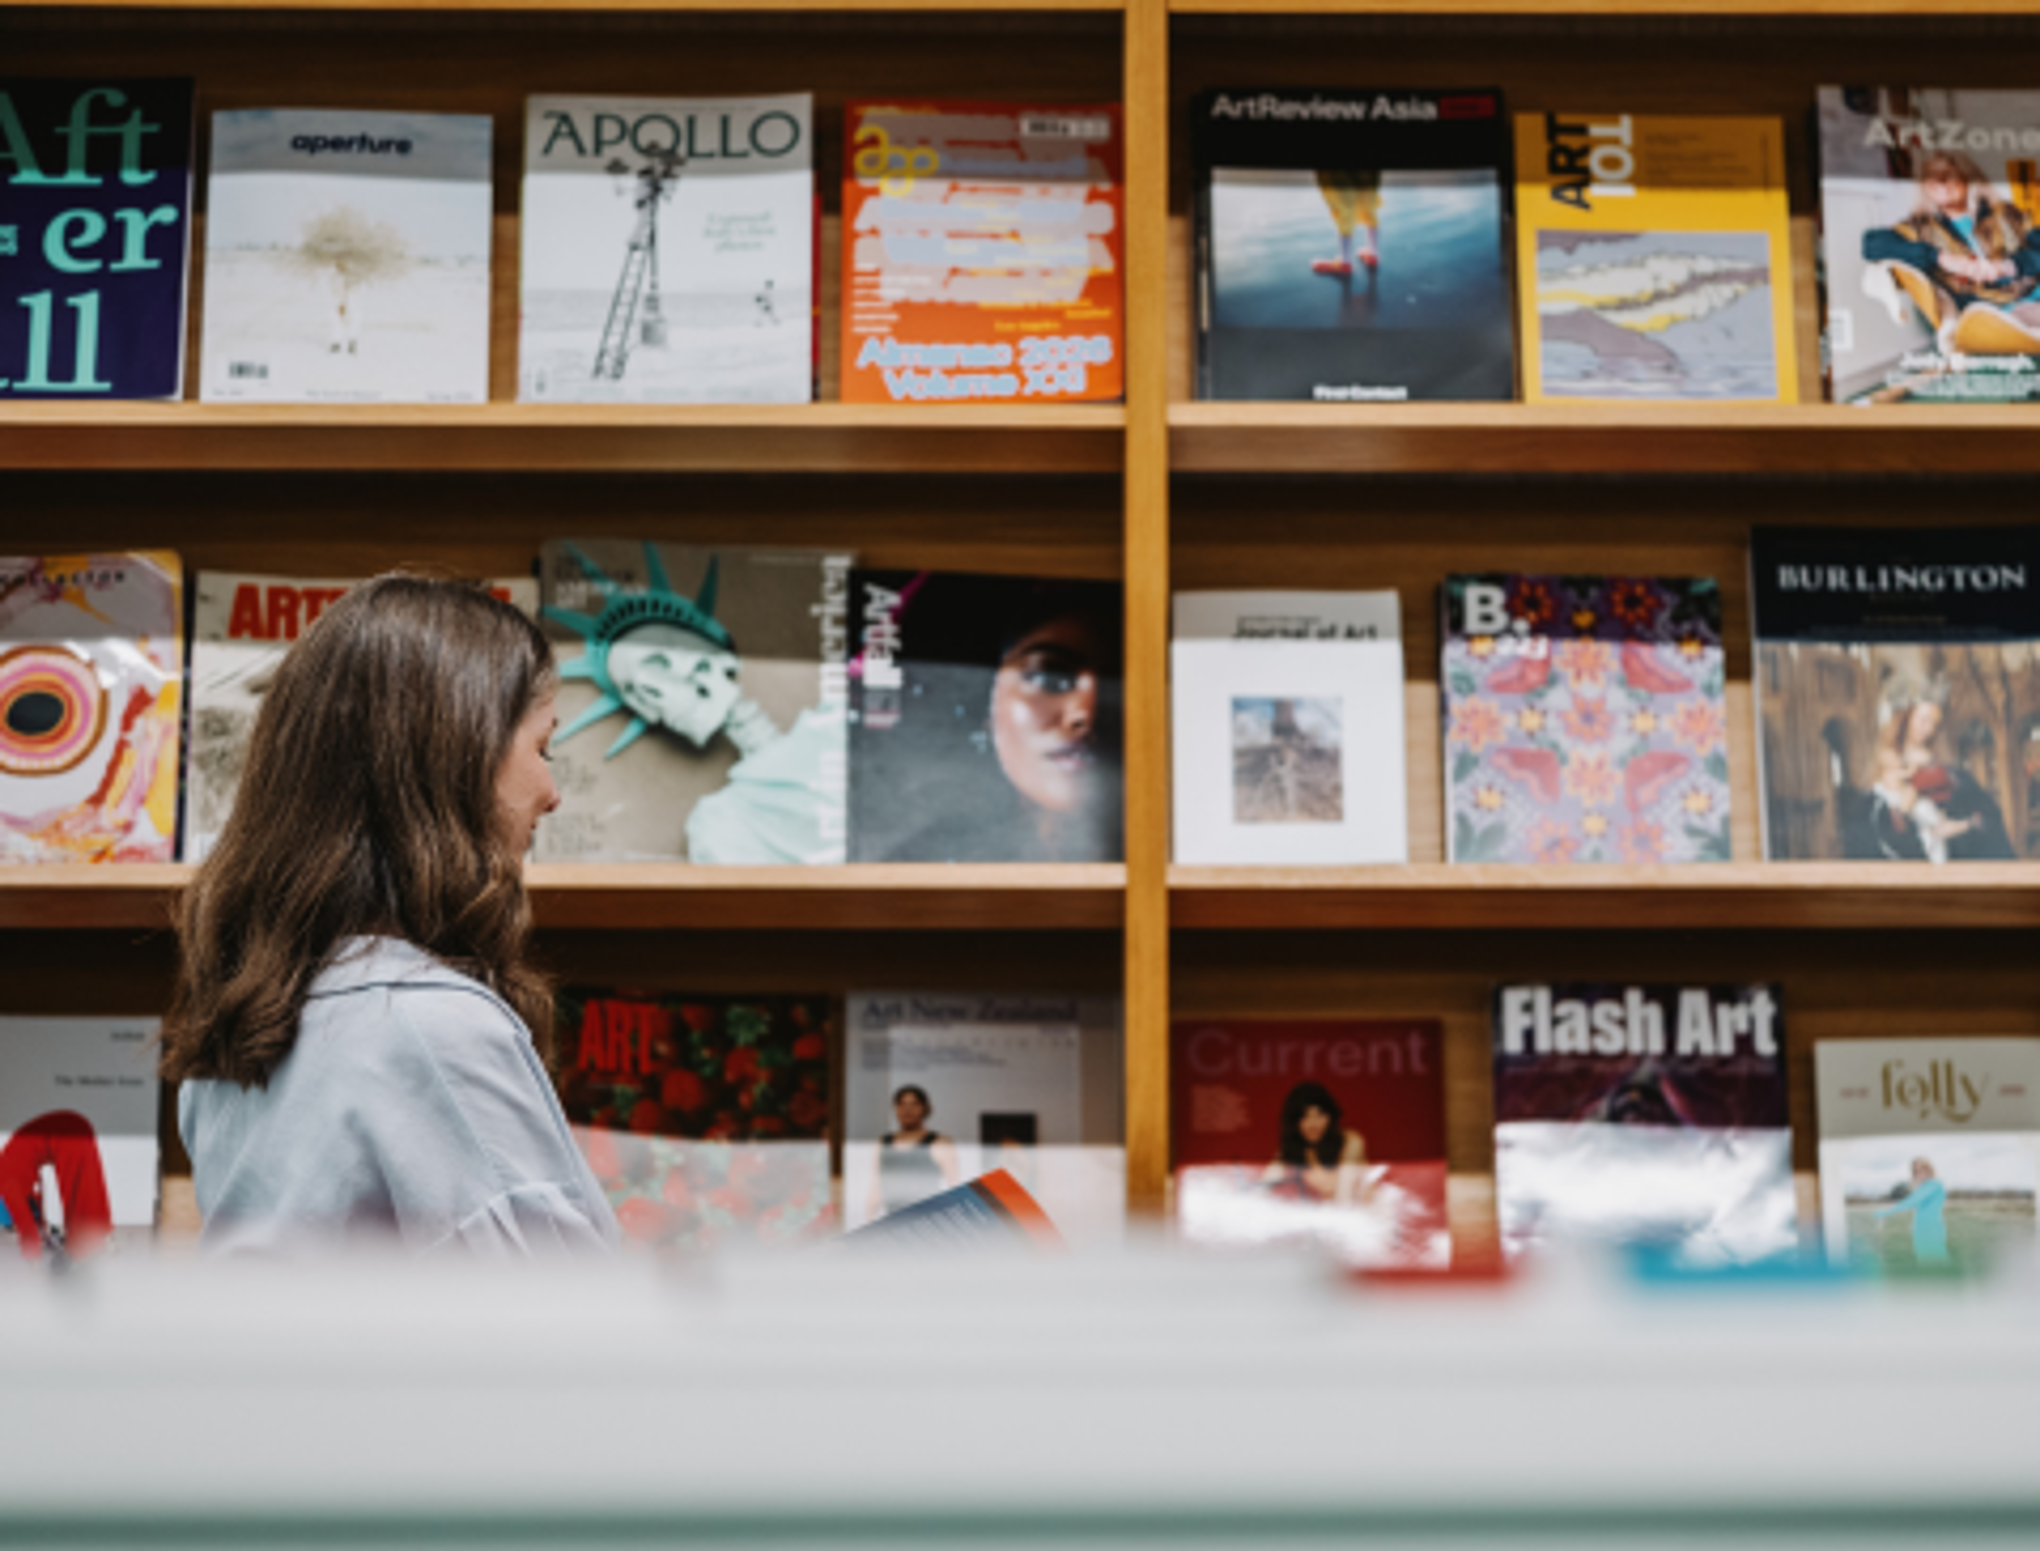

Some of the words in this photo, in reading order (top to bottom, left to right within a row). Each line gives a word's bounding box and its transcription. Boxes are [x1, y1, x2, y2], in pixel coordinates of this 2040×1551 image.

[1210, 93, 1364, 119] ArtReview
[1369, 95, 1438, 119] Asia
[290, 130, 412, 156] aperture
[540, 110, 801, 159] APOLLO
[1545, 112, 1592, 211] ART
[42, 205, 179, 272] er
[0, 290, 112, 391] ll
[856, 336, 1013, 369] Almanac
[882, 367, 1019, 399] Volume
[1777, 564, 2027, 590] BURLINGTON
[1343, 624, 1379, 641] Art
[1464, 584, 1530, 635] B.
[806, 556, 852, 728] America
[864, 1001, 905, 1021] Art
[911, 1001, 968, 1021] New
[977, 1000, 1079, 1021] Zealand
[1502, 985, 1664, 1055] Flash
[1675, 986, 1778, 1056] Art
[578, 999, 661, 1074] ART
[1187, 1029, 1427, 1077] Current
[1881, 1058, 1990, 1124] folly
